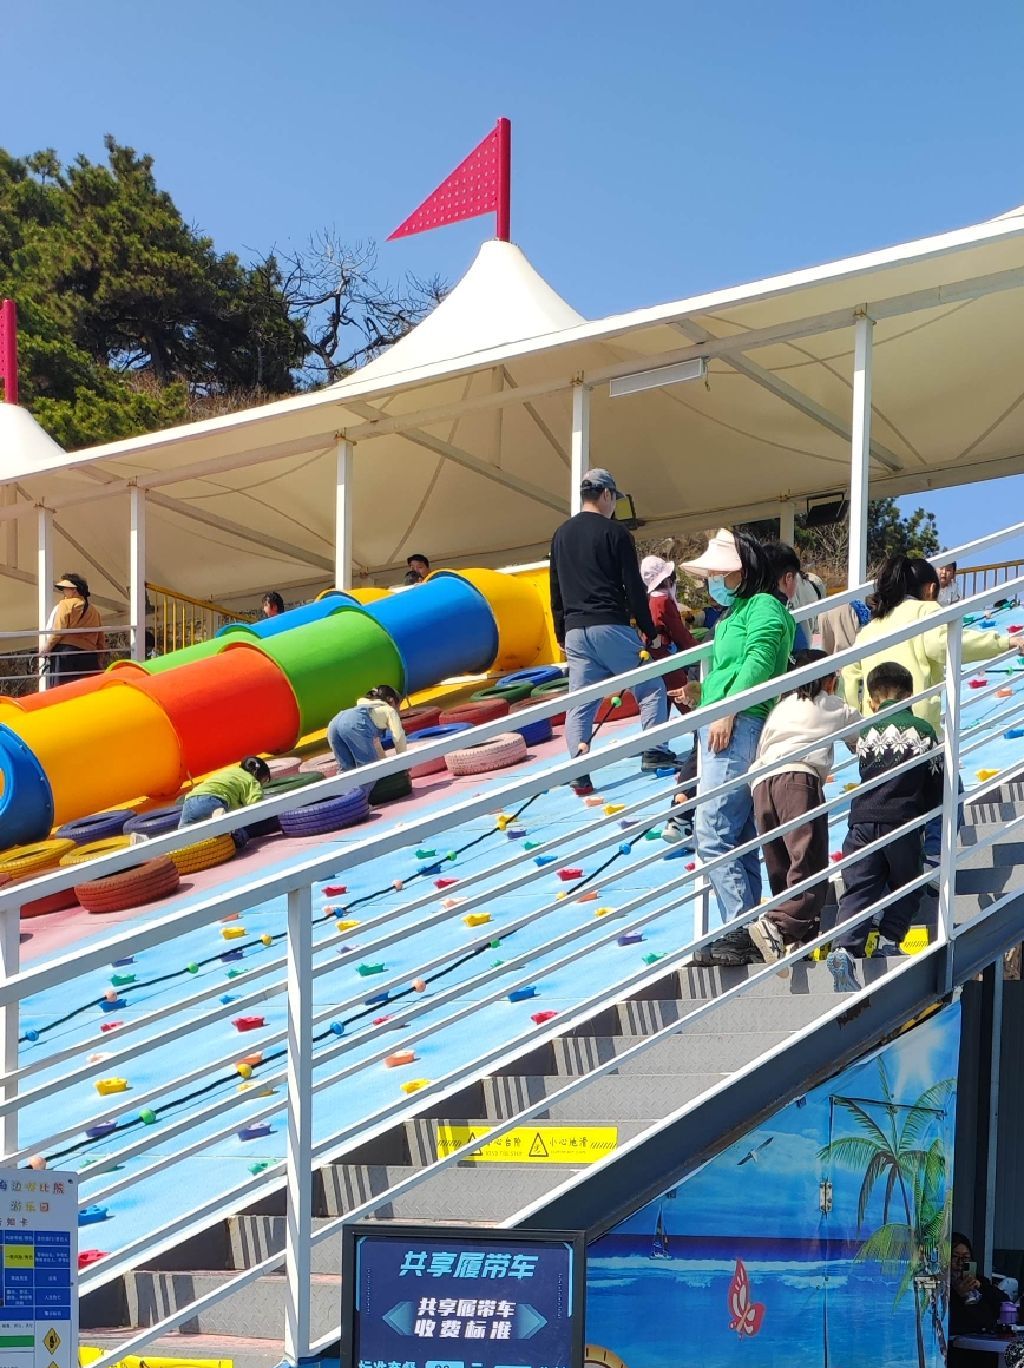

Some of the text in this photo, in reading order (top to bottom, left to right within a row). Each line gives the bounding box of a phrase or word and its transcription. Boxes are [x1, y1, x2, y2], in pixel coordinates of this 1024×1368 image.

[399, 1250, 539, 1280] 共享履带车
[417, 1297, 517, 1318] 共享履带车
[414, 1317, 513, 1340] 收费标准
